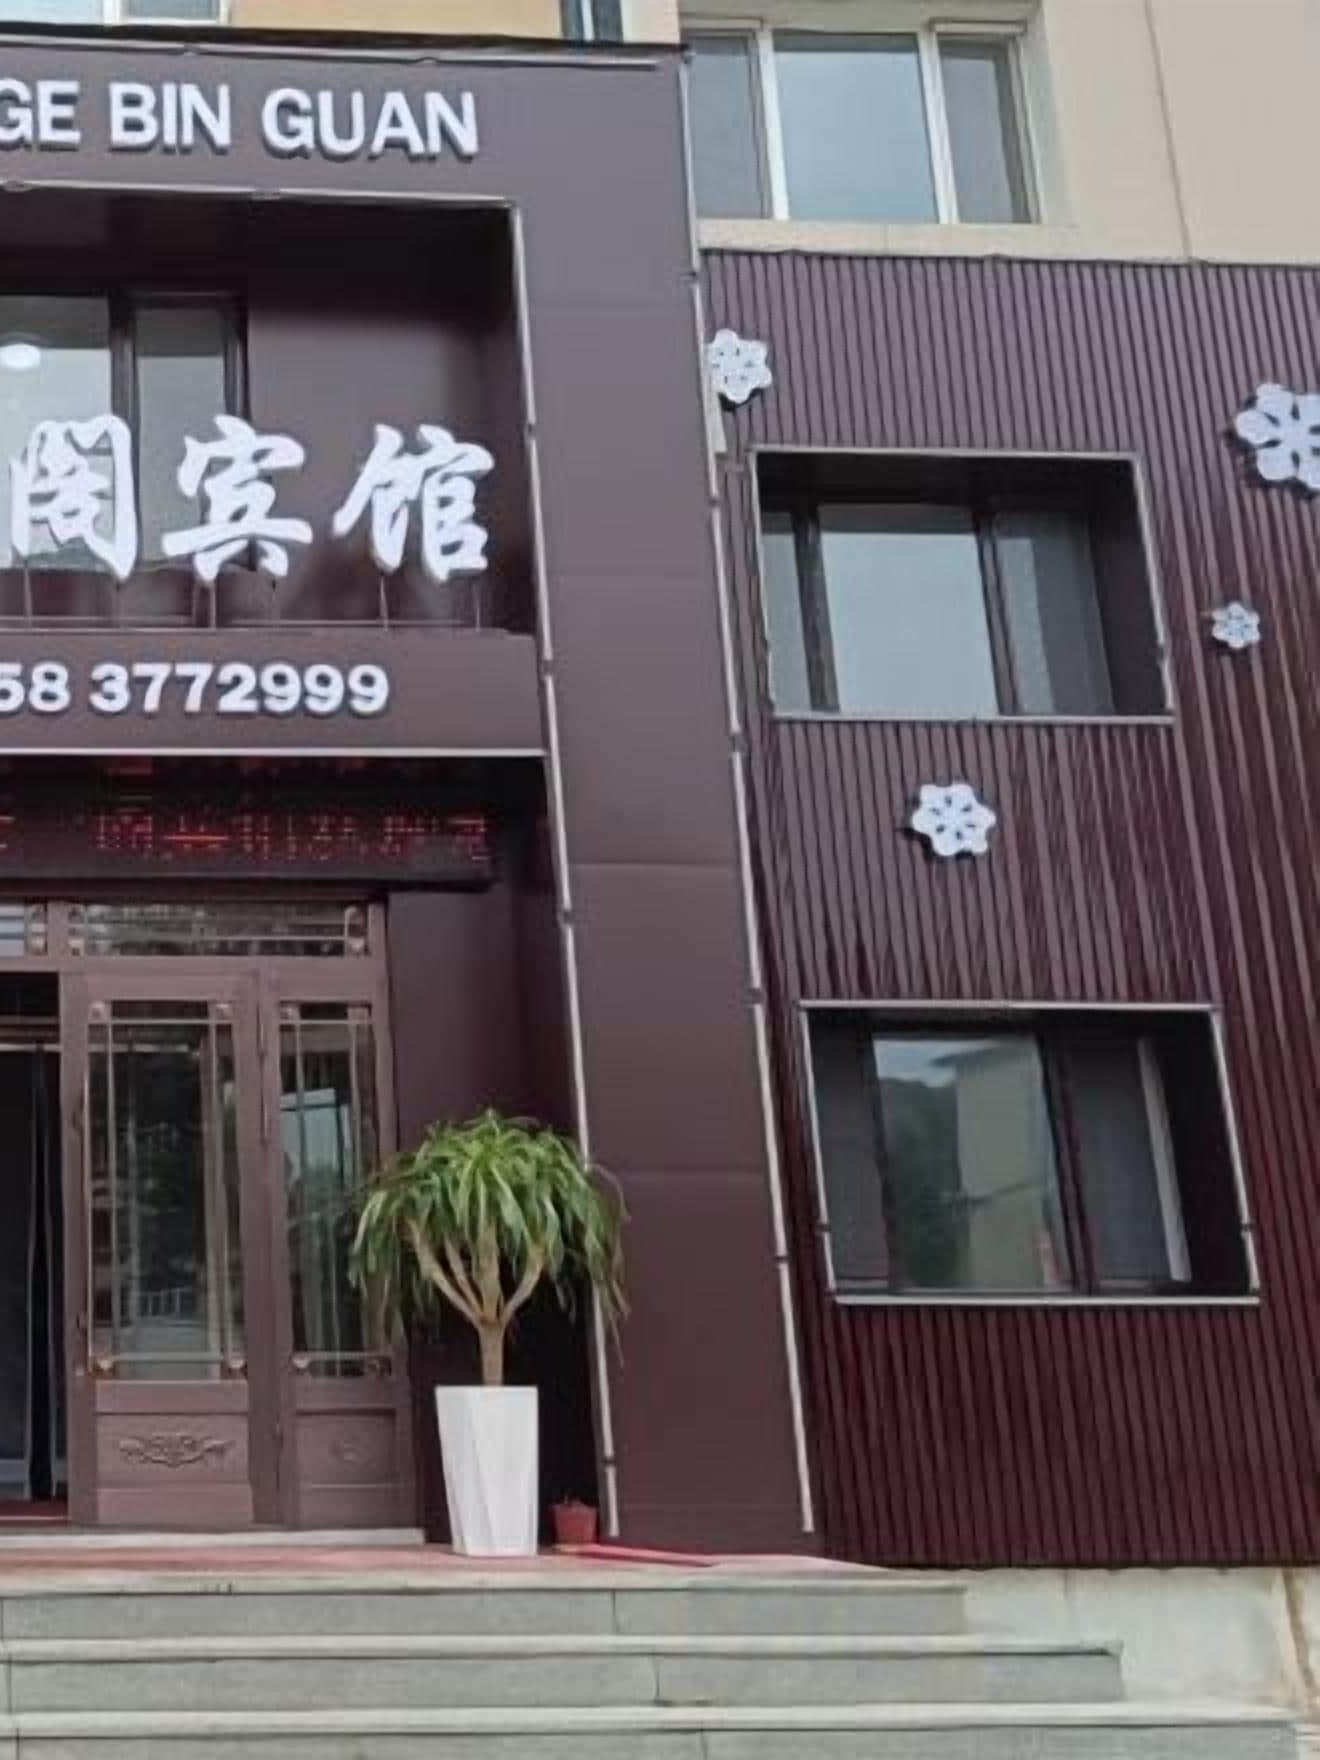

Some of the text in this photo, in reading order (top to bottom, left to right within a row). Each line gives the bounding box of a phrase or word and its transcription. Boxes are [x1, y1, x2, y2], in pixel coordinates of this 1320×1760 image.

[108, 81, 232, 149] BIN
[261, 87, 479, 156] GUAN
[89, 662, 389, 715] 3772999
